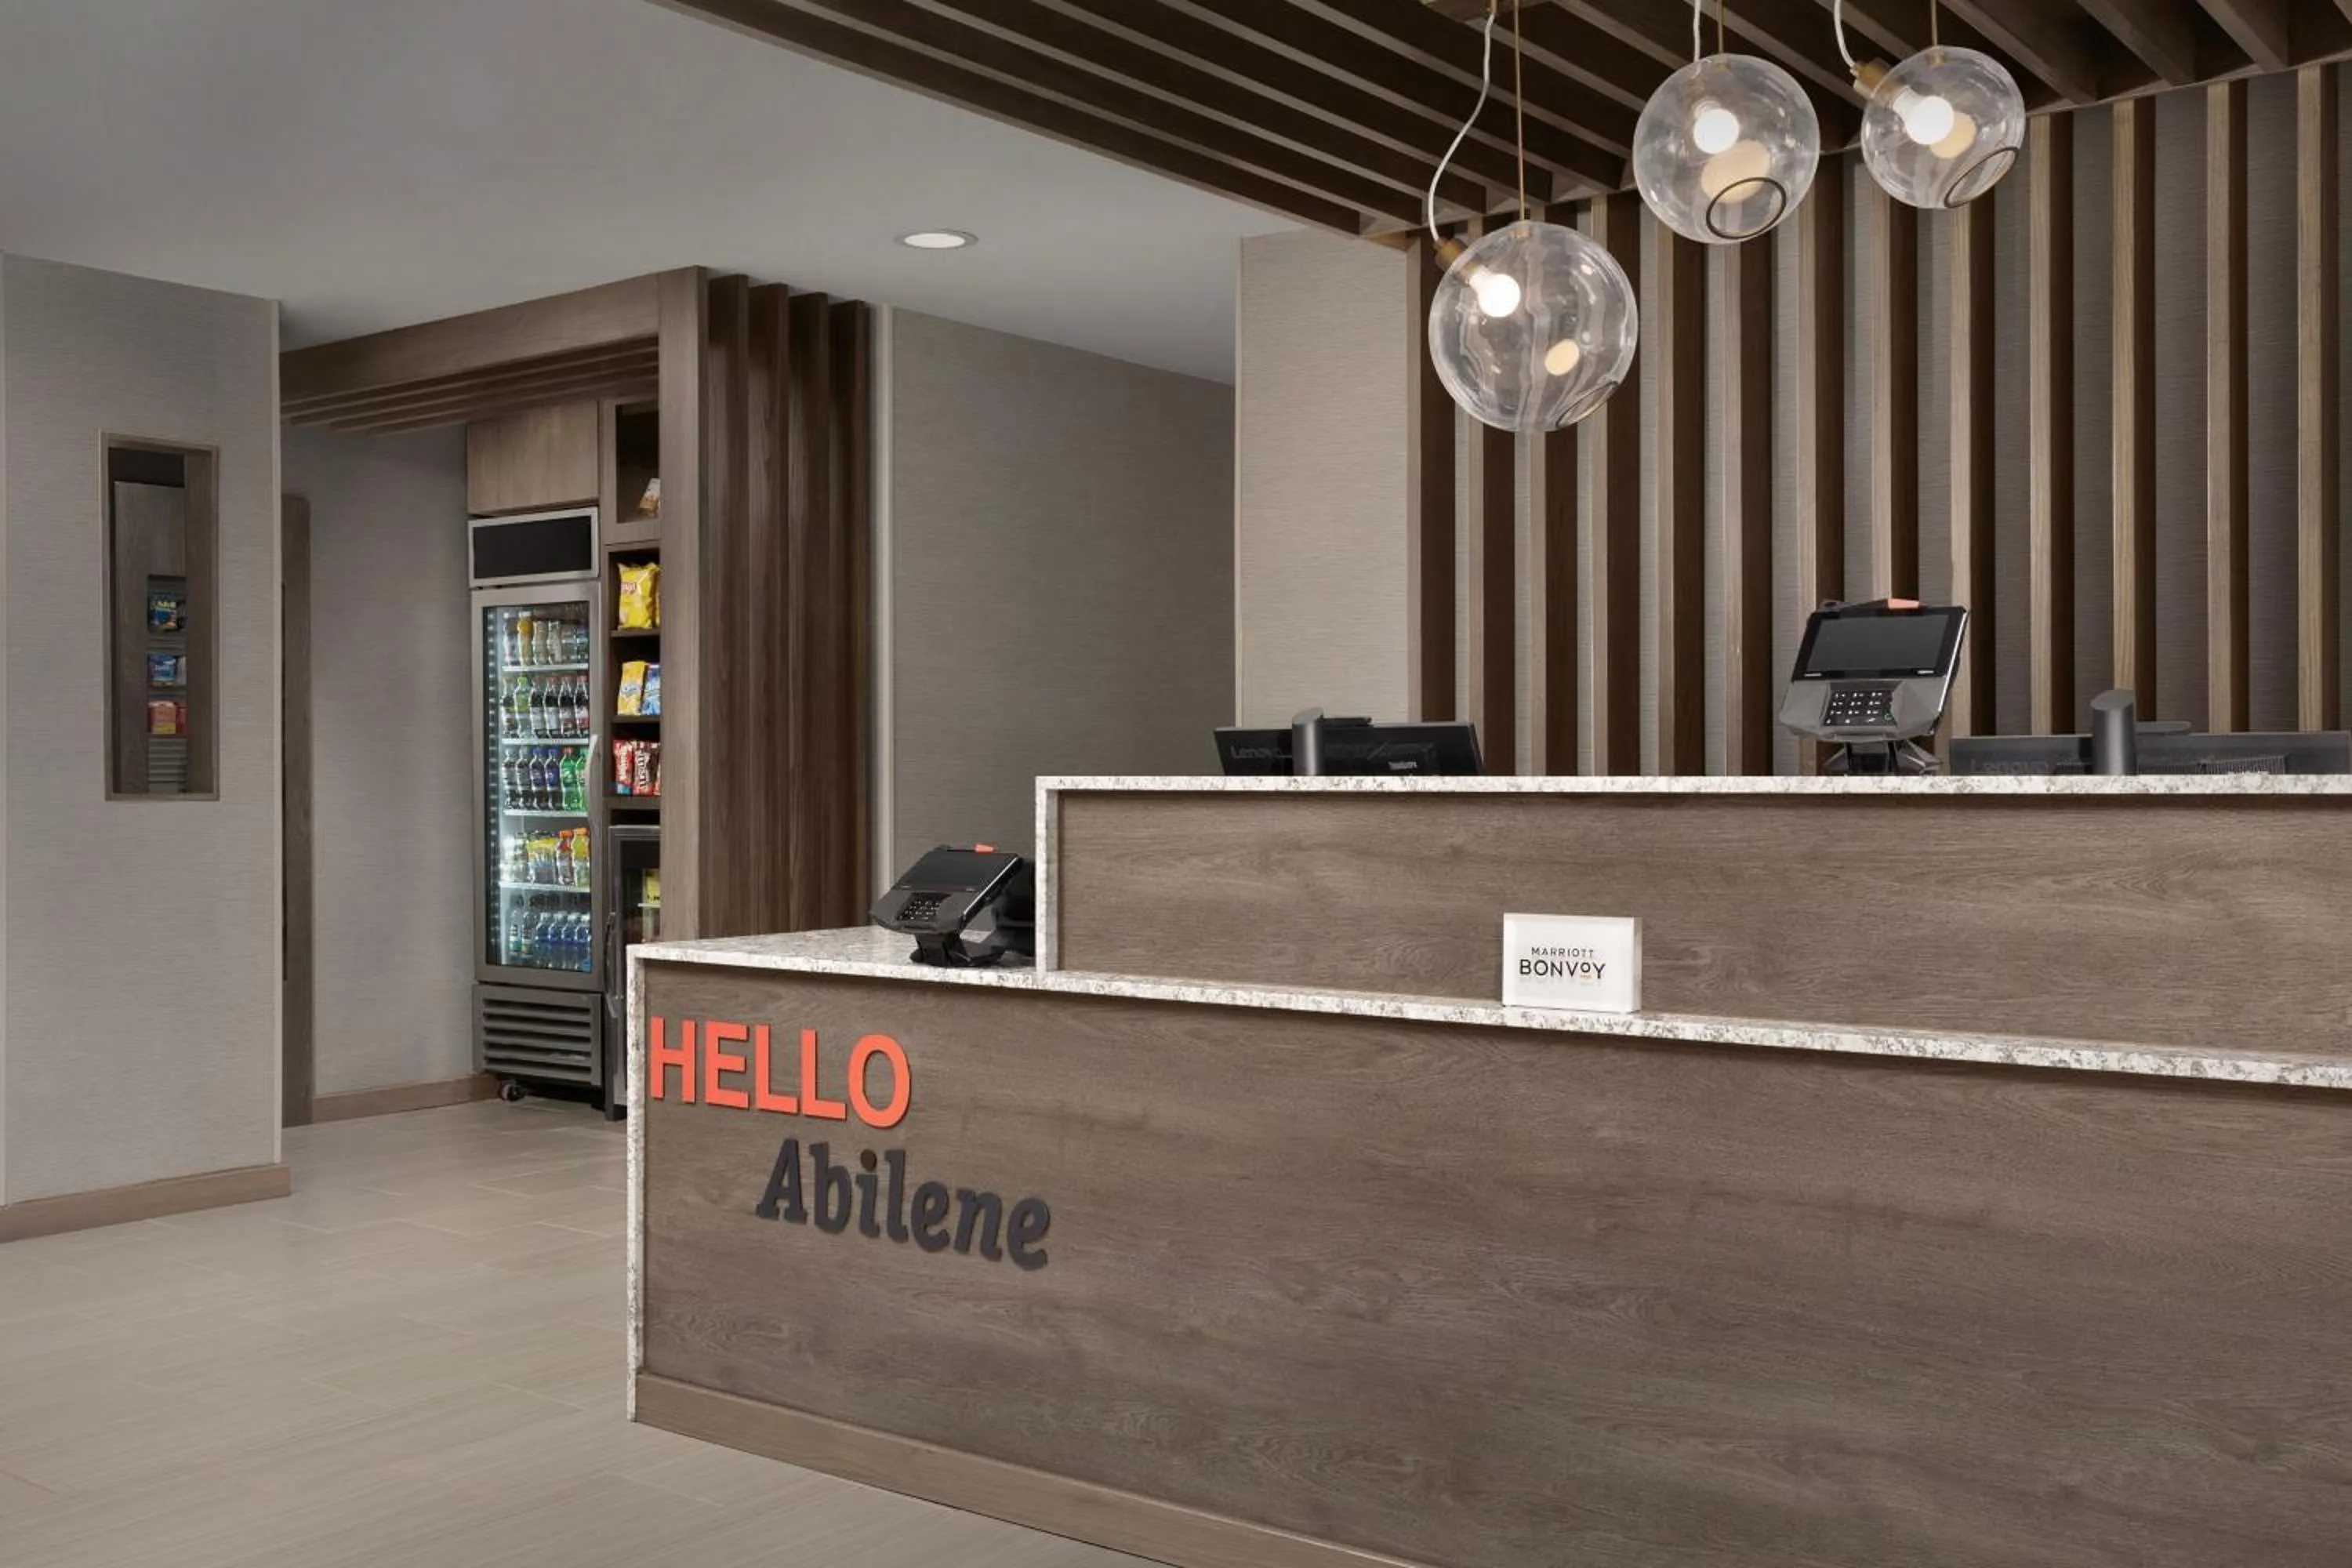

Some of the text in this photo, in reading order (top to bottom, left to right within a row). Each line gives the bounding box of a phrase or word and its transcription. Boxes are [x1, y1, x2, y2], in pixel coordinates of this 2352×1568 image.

[1519, 959, 1606, 979] BONVOY
[1531, 947, 1594, 958] MARRIOTT
[650, 1016, 911, 1129] HELLO
[756, 1138, 1051, 1271] Abilene
